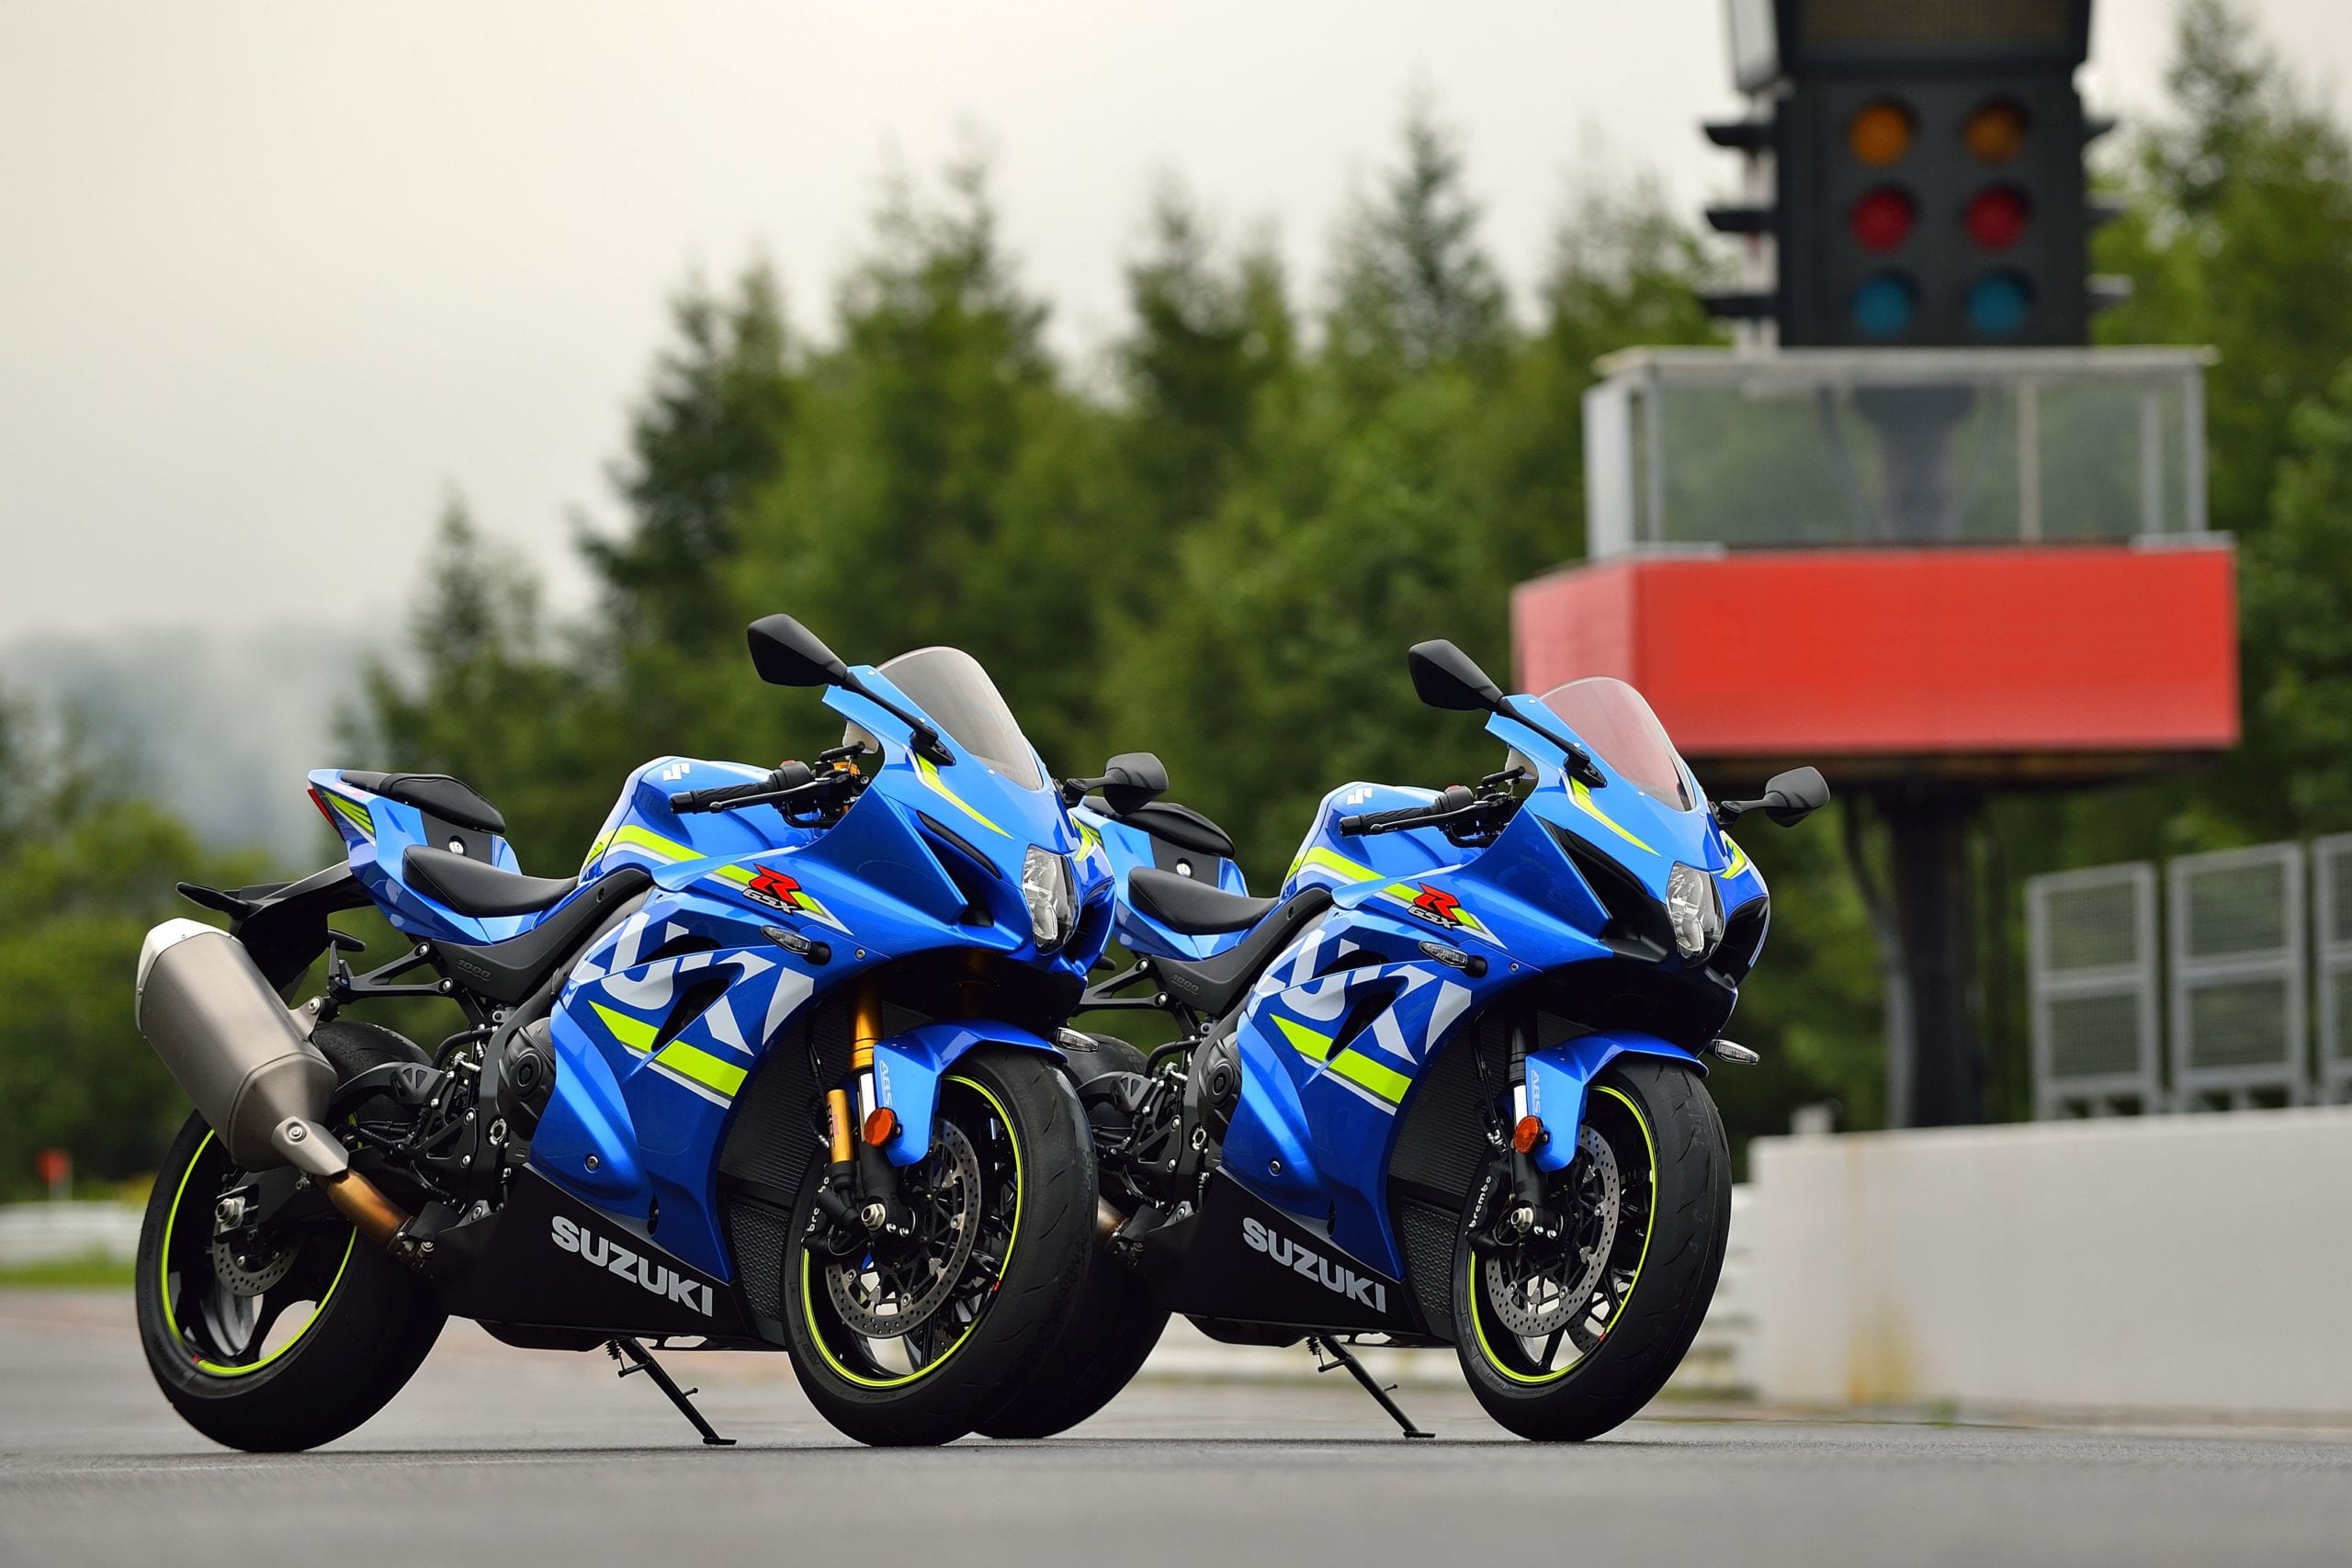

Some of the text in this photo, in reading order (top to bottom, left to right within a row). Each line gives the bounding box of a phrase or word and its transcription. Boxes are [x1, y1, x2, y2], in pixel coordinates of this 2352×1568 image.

[879, 1059, 893, 1109] ABS
[807, 1176, 830, 1232] breo
[1468, 1176, 1492, 1228] brembo
[551, 1215, 713, 1317] SUZUKI
[1242, 1217, 1386, 1314] SUZUKI
